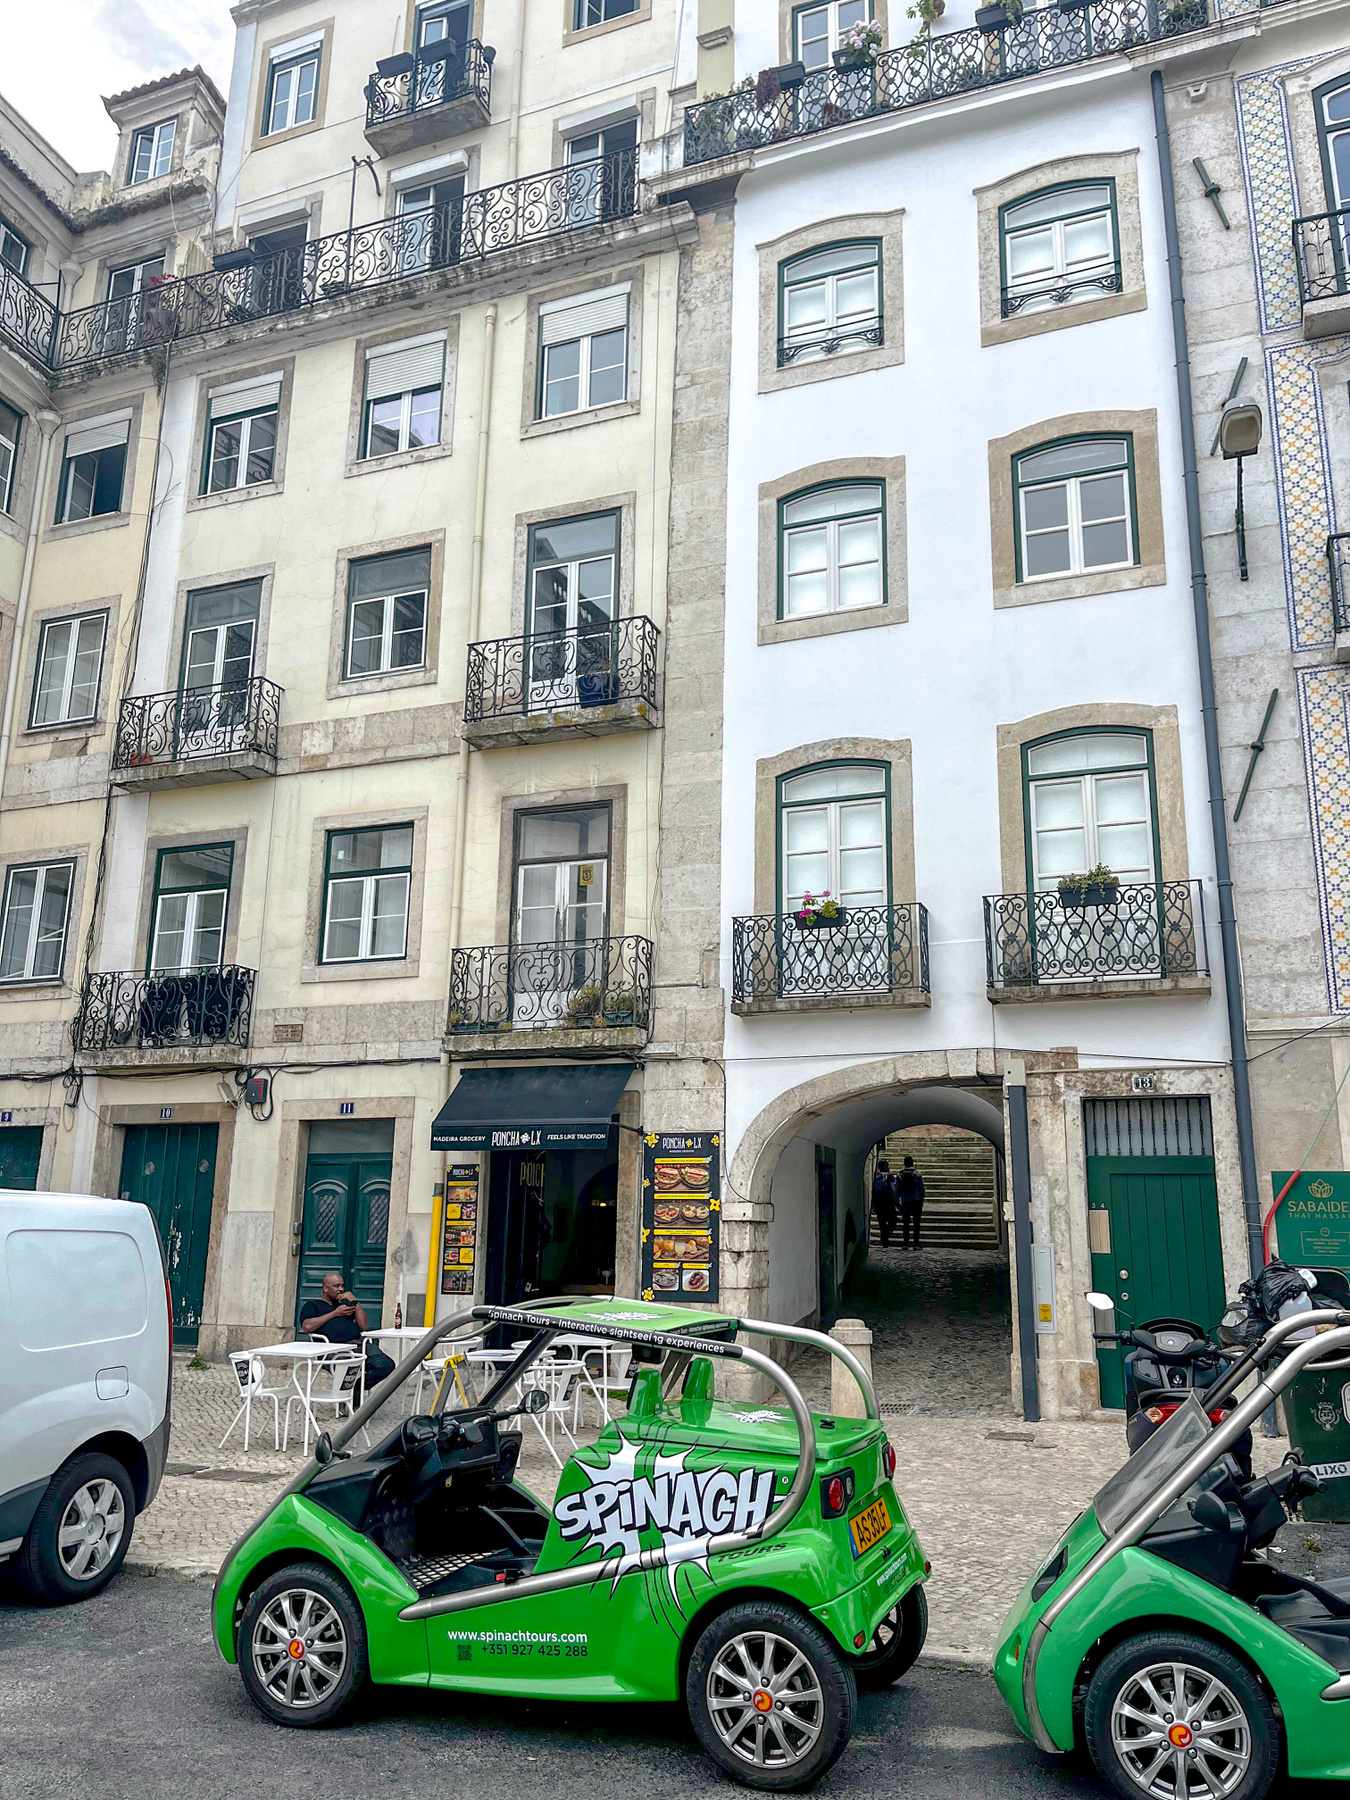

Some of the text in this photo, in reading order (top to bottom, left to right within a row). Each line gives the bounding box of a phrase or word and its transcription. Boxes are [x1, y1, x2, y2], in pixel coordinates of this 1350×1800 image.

[162, 1108, 170, 1118] 10
[491, 1130, 542, 1147] PONCHA LX
[662, 1137, 702, 1149] PONCHA LX
[488, 1309, 523, 1321] Spinach
[526, 1314, 550, 1326] Tours
[558, 1319, 608, 1335] Interactive
[609, 1327, 664, 1344] sightseeing
[666, 1337, 725, 1354] experiences
[1315, 1463, 1348, 1476] LIXO
[718, 1542, 788, 1562] TOURS
[447, 1629, 588, 1643] www.spinachtours.com
[481, 1643, 588, 1657] +351 927 425 288
